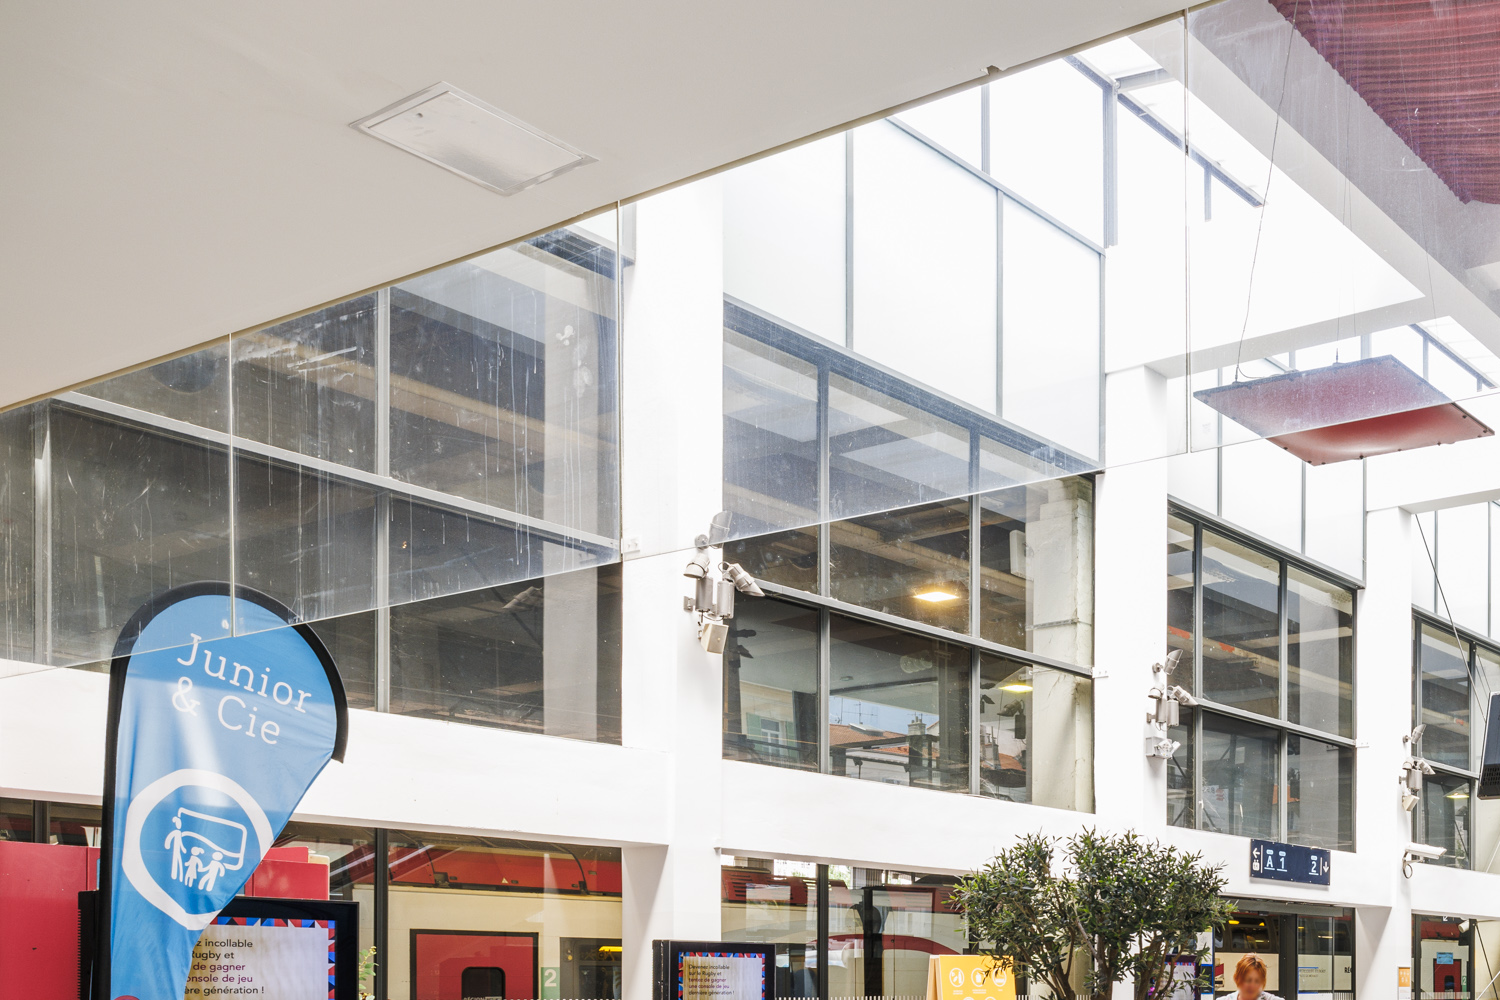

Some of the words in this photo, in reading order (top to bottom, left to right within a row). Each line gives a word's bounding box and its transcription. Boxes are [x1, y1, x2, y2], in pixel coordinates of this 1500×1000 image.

[177, 632, 312, 713] Junior
[172, 676, 201, 717] &
[217, 675, 280, 745] Cie
[1266, 855, 1274, 868] A
[1280, 857, 1285, 869] 1
[1311, 861, 1317, 873] 2
[205, 938, 253, 948] incollable
[224, 951, 235, 959] et
[193, 962, 206, 971] de
[209, 964, 246, 973] gagner
[186, 974, 219, 983] onsole
[221, 974, 235, 983] de
[237, 974, 253, 984] jeu
[544, 969, 557, 987] 2
[1462, 977, 1467, 985] 2
[203, 985, 258, 996] génération
